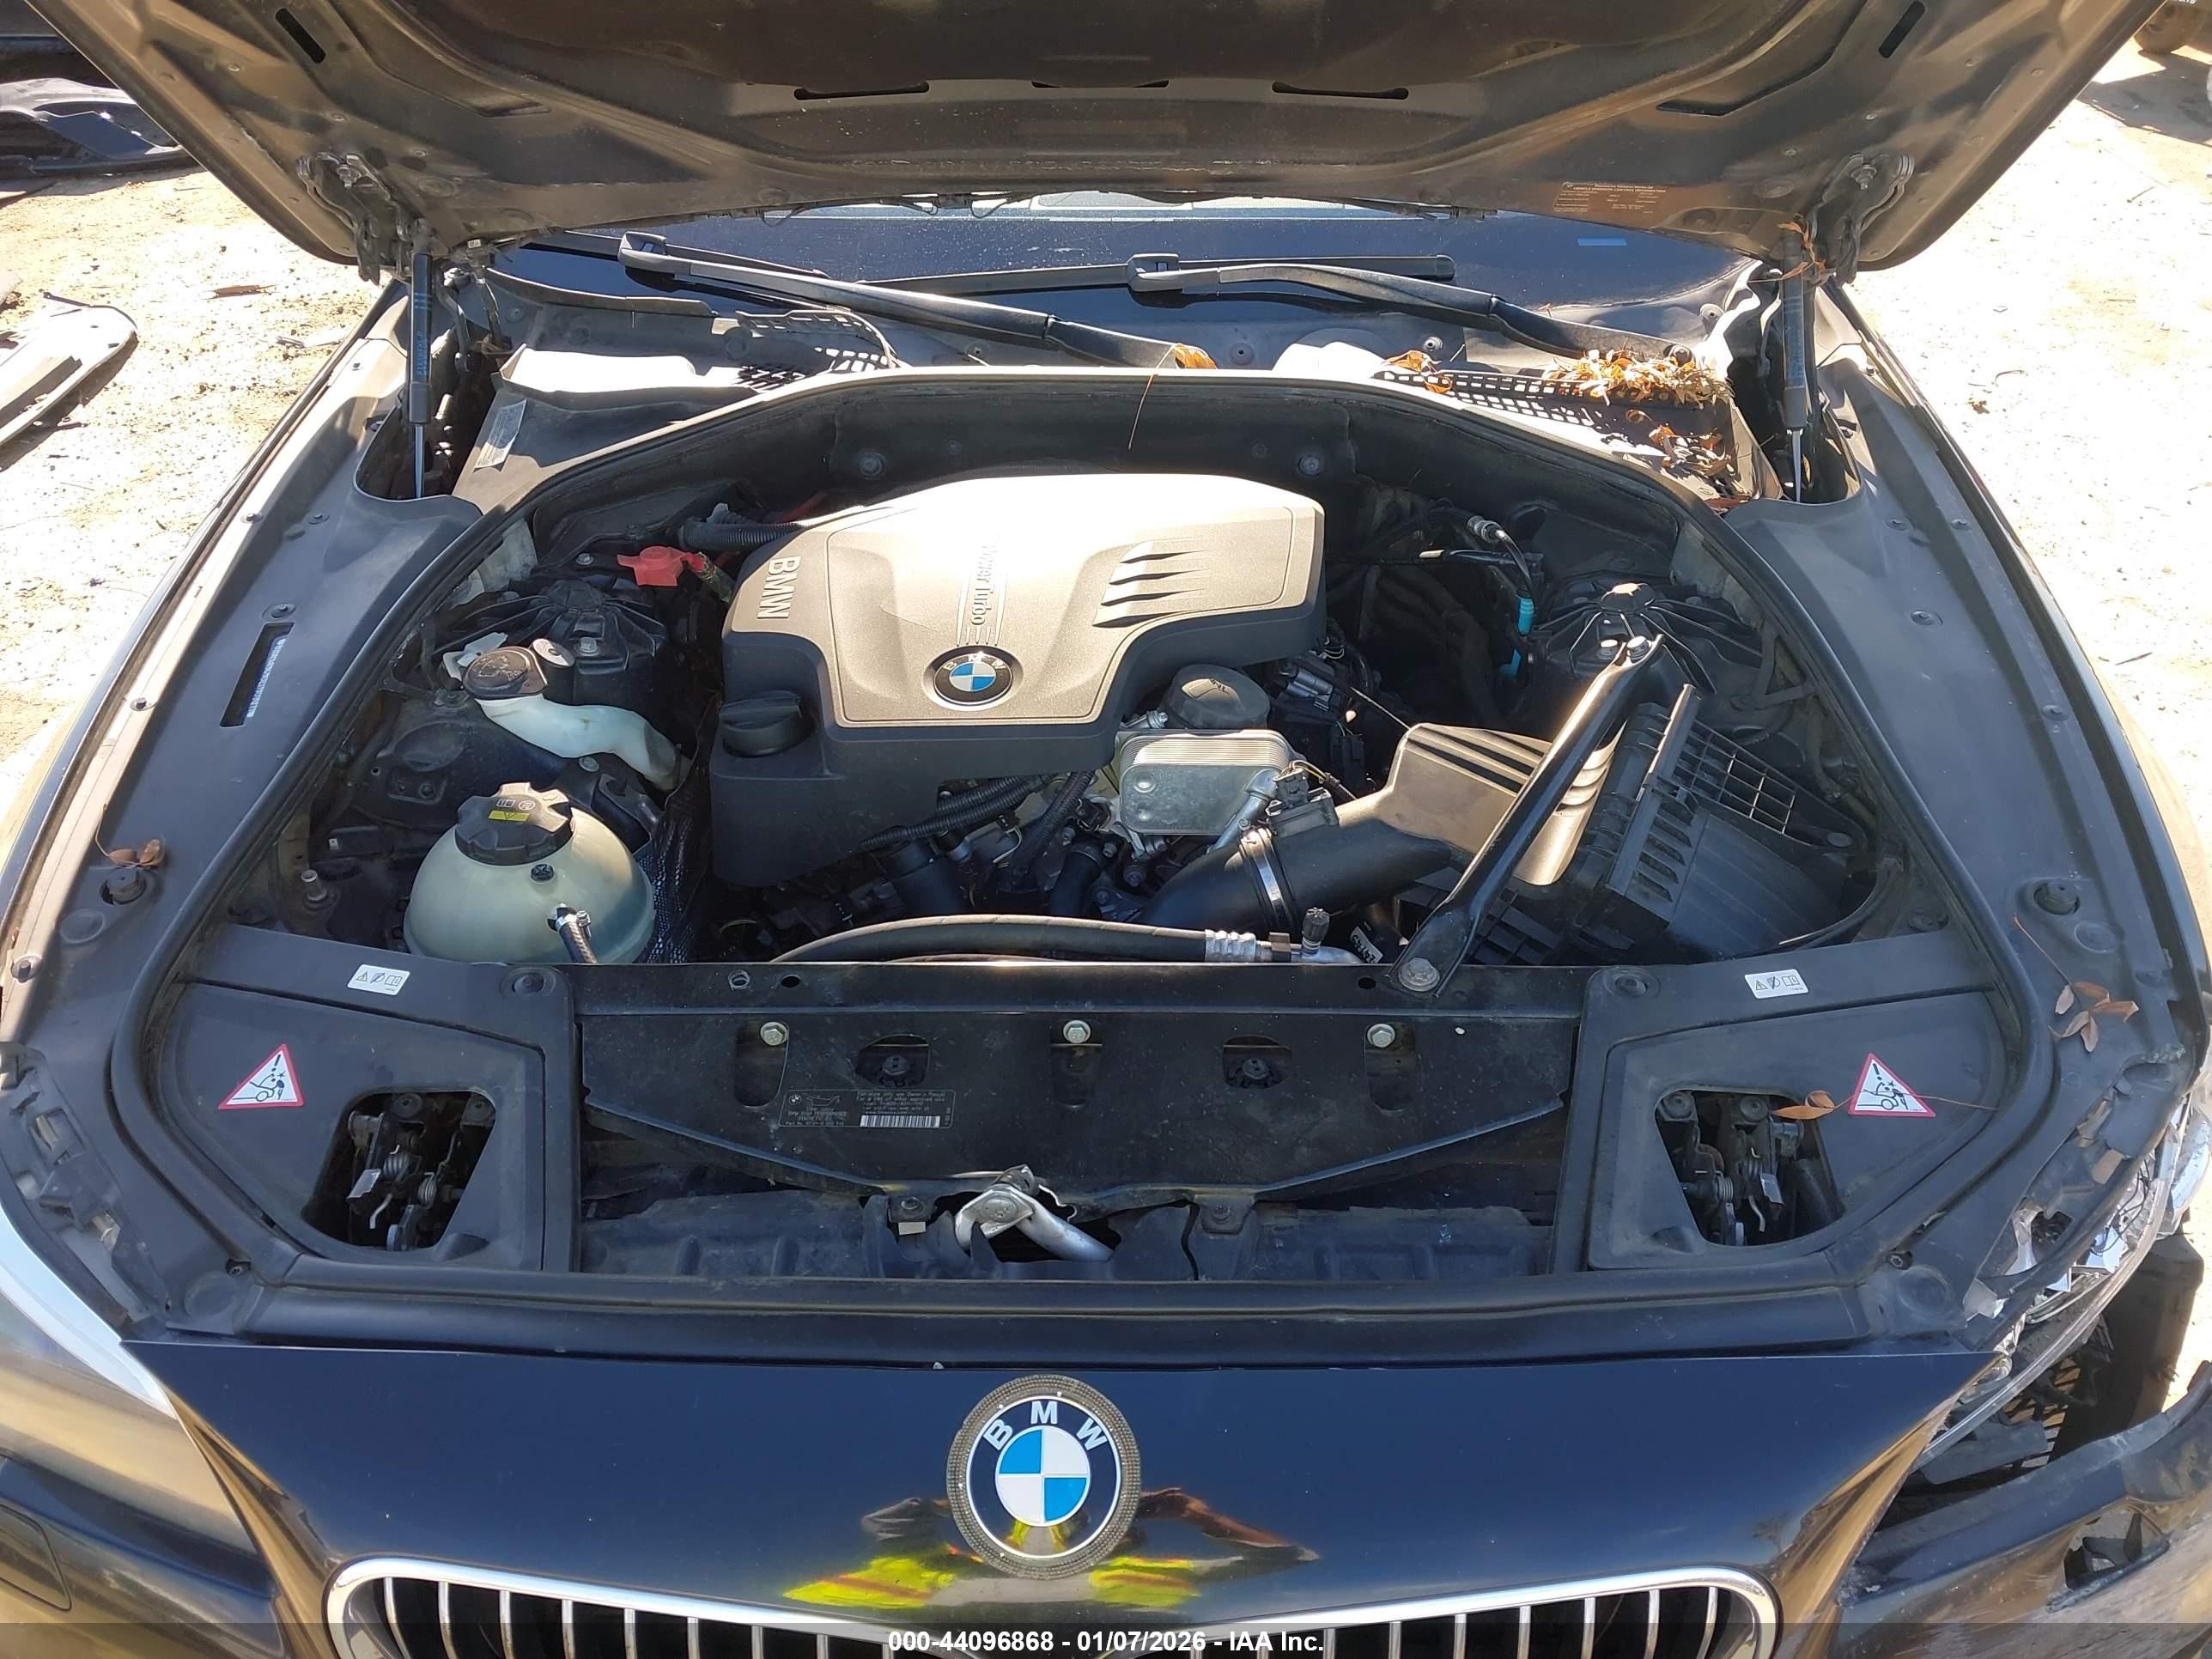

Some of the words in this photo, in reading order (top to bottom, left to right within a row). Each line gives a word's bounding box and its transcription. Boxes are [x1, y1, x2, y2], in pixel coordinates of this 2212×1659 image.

[757, 556, 802, 620] BMW
[970, 584, 996, 626] Turbo
[942, 653, 1007, 672] BMW
[983, 1401, 1108, 1451] BMW
